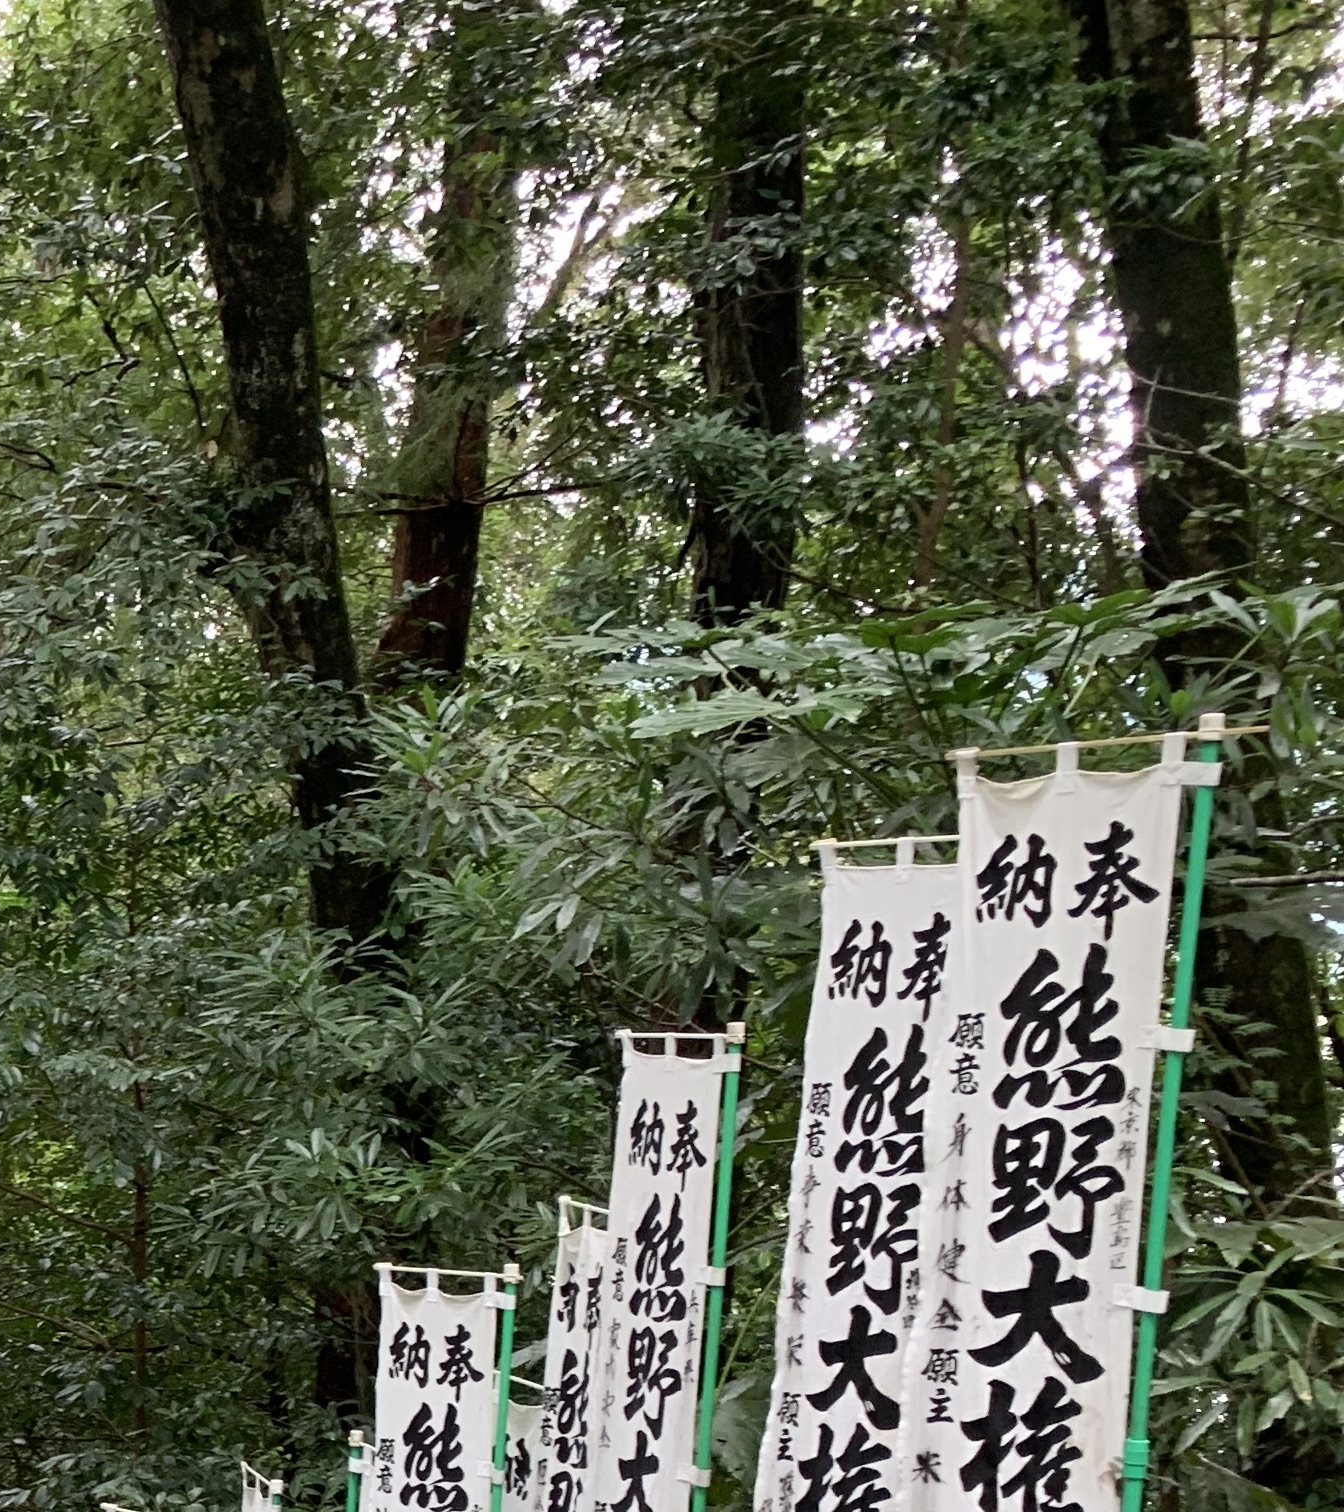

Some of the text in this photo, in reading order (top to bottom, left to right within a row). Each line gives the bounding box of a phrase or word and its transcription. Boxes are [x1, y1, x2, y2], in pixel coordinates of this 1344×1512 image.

[977, 820, 1161, 941] 奉納
[948, 1012, 986, 1095] 願意
[629, 1099, 706, 1192] 奉納
[804, 1083, 833, 1158] 願意
[929, 1112, 974, 1332] 身体健全
[389, 1321, 485, 1404] 奉納
[920, 1348, 960, 1424] 願主
[776, 1391, 803, 1463] 願主
